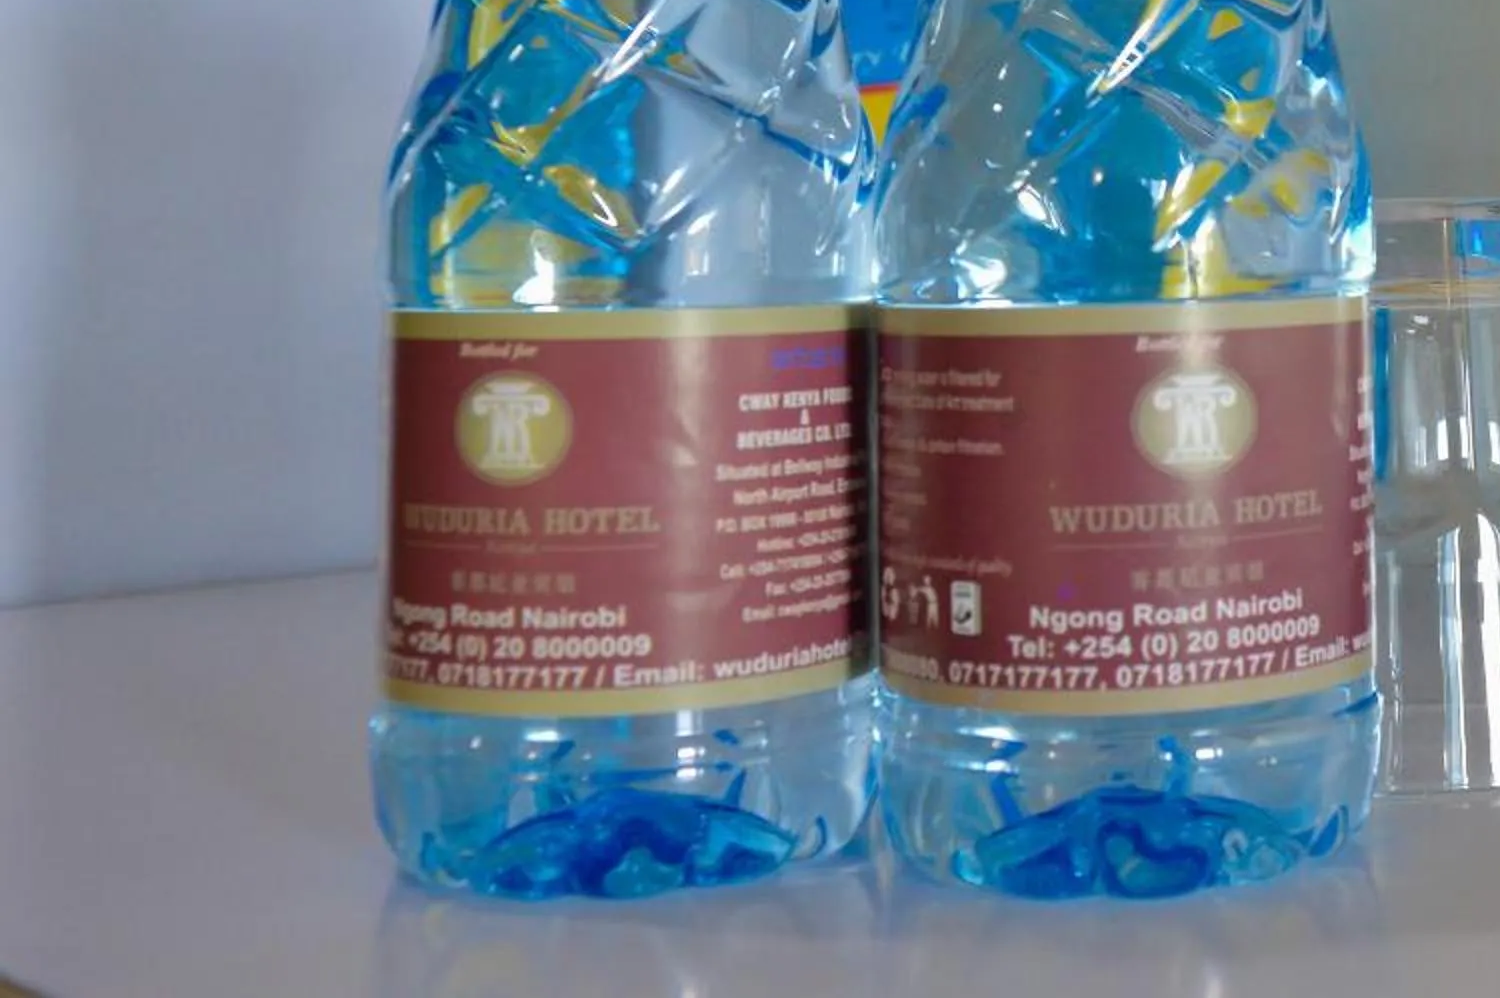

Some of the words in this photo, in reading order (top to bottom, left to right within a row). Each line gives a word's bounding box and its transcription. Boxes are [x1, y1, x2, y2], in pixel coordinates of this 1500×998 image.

[545, 506, 661, 535] HOTEL
[1049, 500, 1221, 533] WUDURIA
[1235, 489, 1323, 524] HOTEL
[450, 603, 515, 629] Road
[521, 605, 627, 630] Nairobi
[1029, 606, 1124, 633] Ngong
[1132, 600, 1208, 627] Road
[1216, 588, 1304, 620] Nairobi
[456, 634, 487, 661] (0)
[492, 635, 525, 660] 20
[531, 633, 653, 660] 8000009
[1008, 633, 1056, 659] Tel:
[1063, 635, 1132, 659] +254
[1140, 633, 1178, 660] (0)
[1186, 629, 1219, 654] 20
[1226, 614, 1321, 650] 8000009
[612, 661, 704, 688] Email:
[948, 662, 1107, 690] 0717177177,
[1115, 651, 1275, 689] 0718177177
[1294, 634, 1350, 668] Email:
